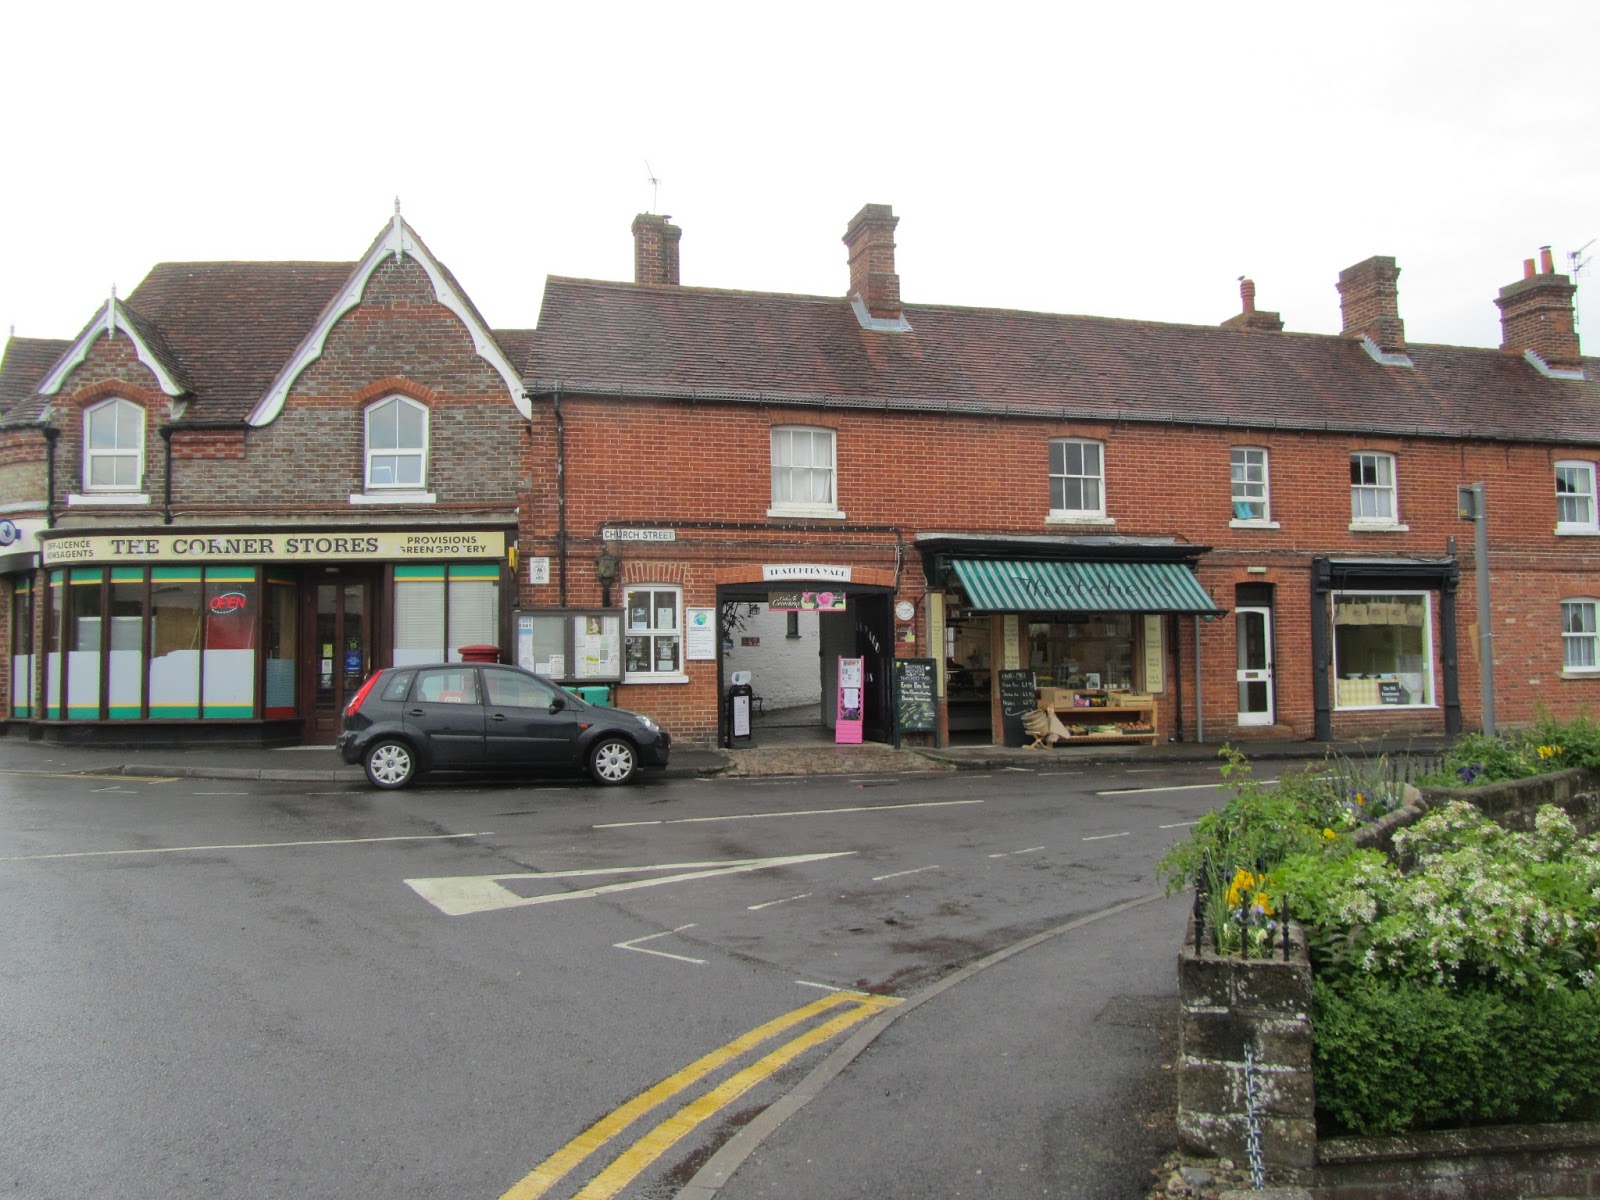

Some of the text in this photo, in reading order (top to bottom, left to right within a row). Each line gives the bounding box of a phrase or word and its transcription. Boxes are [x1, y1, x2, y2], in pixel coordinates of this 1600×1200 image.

[407, 536, 477, 544] PROVISIONS
[604, 530, 674, 540] CHURCH STREET
[111, 537, 379, 555] THE CORNER STORES
[823, 568, 847, 577] YARD
[210, 596, 247, 609] OPEN
